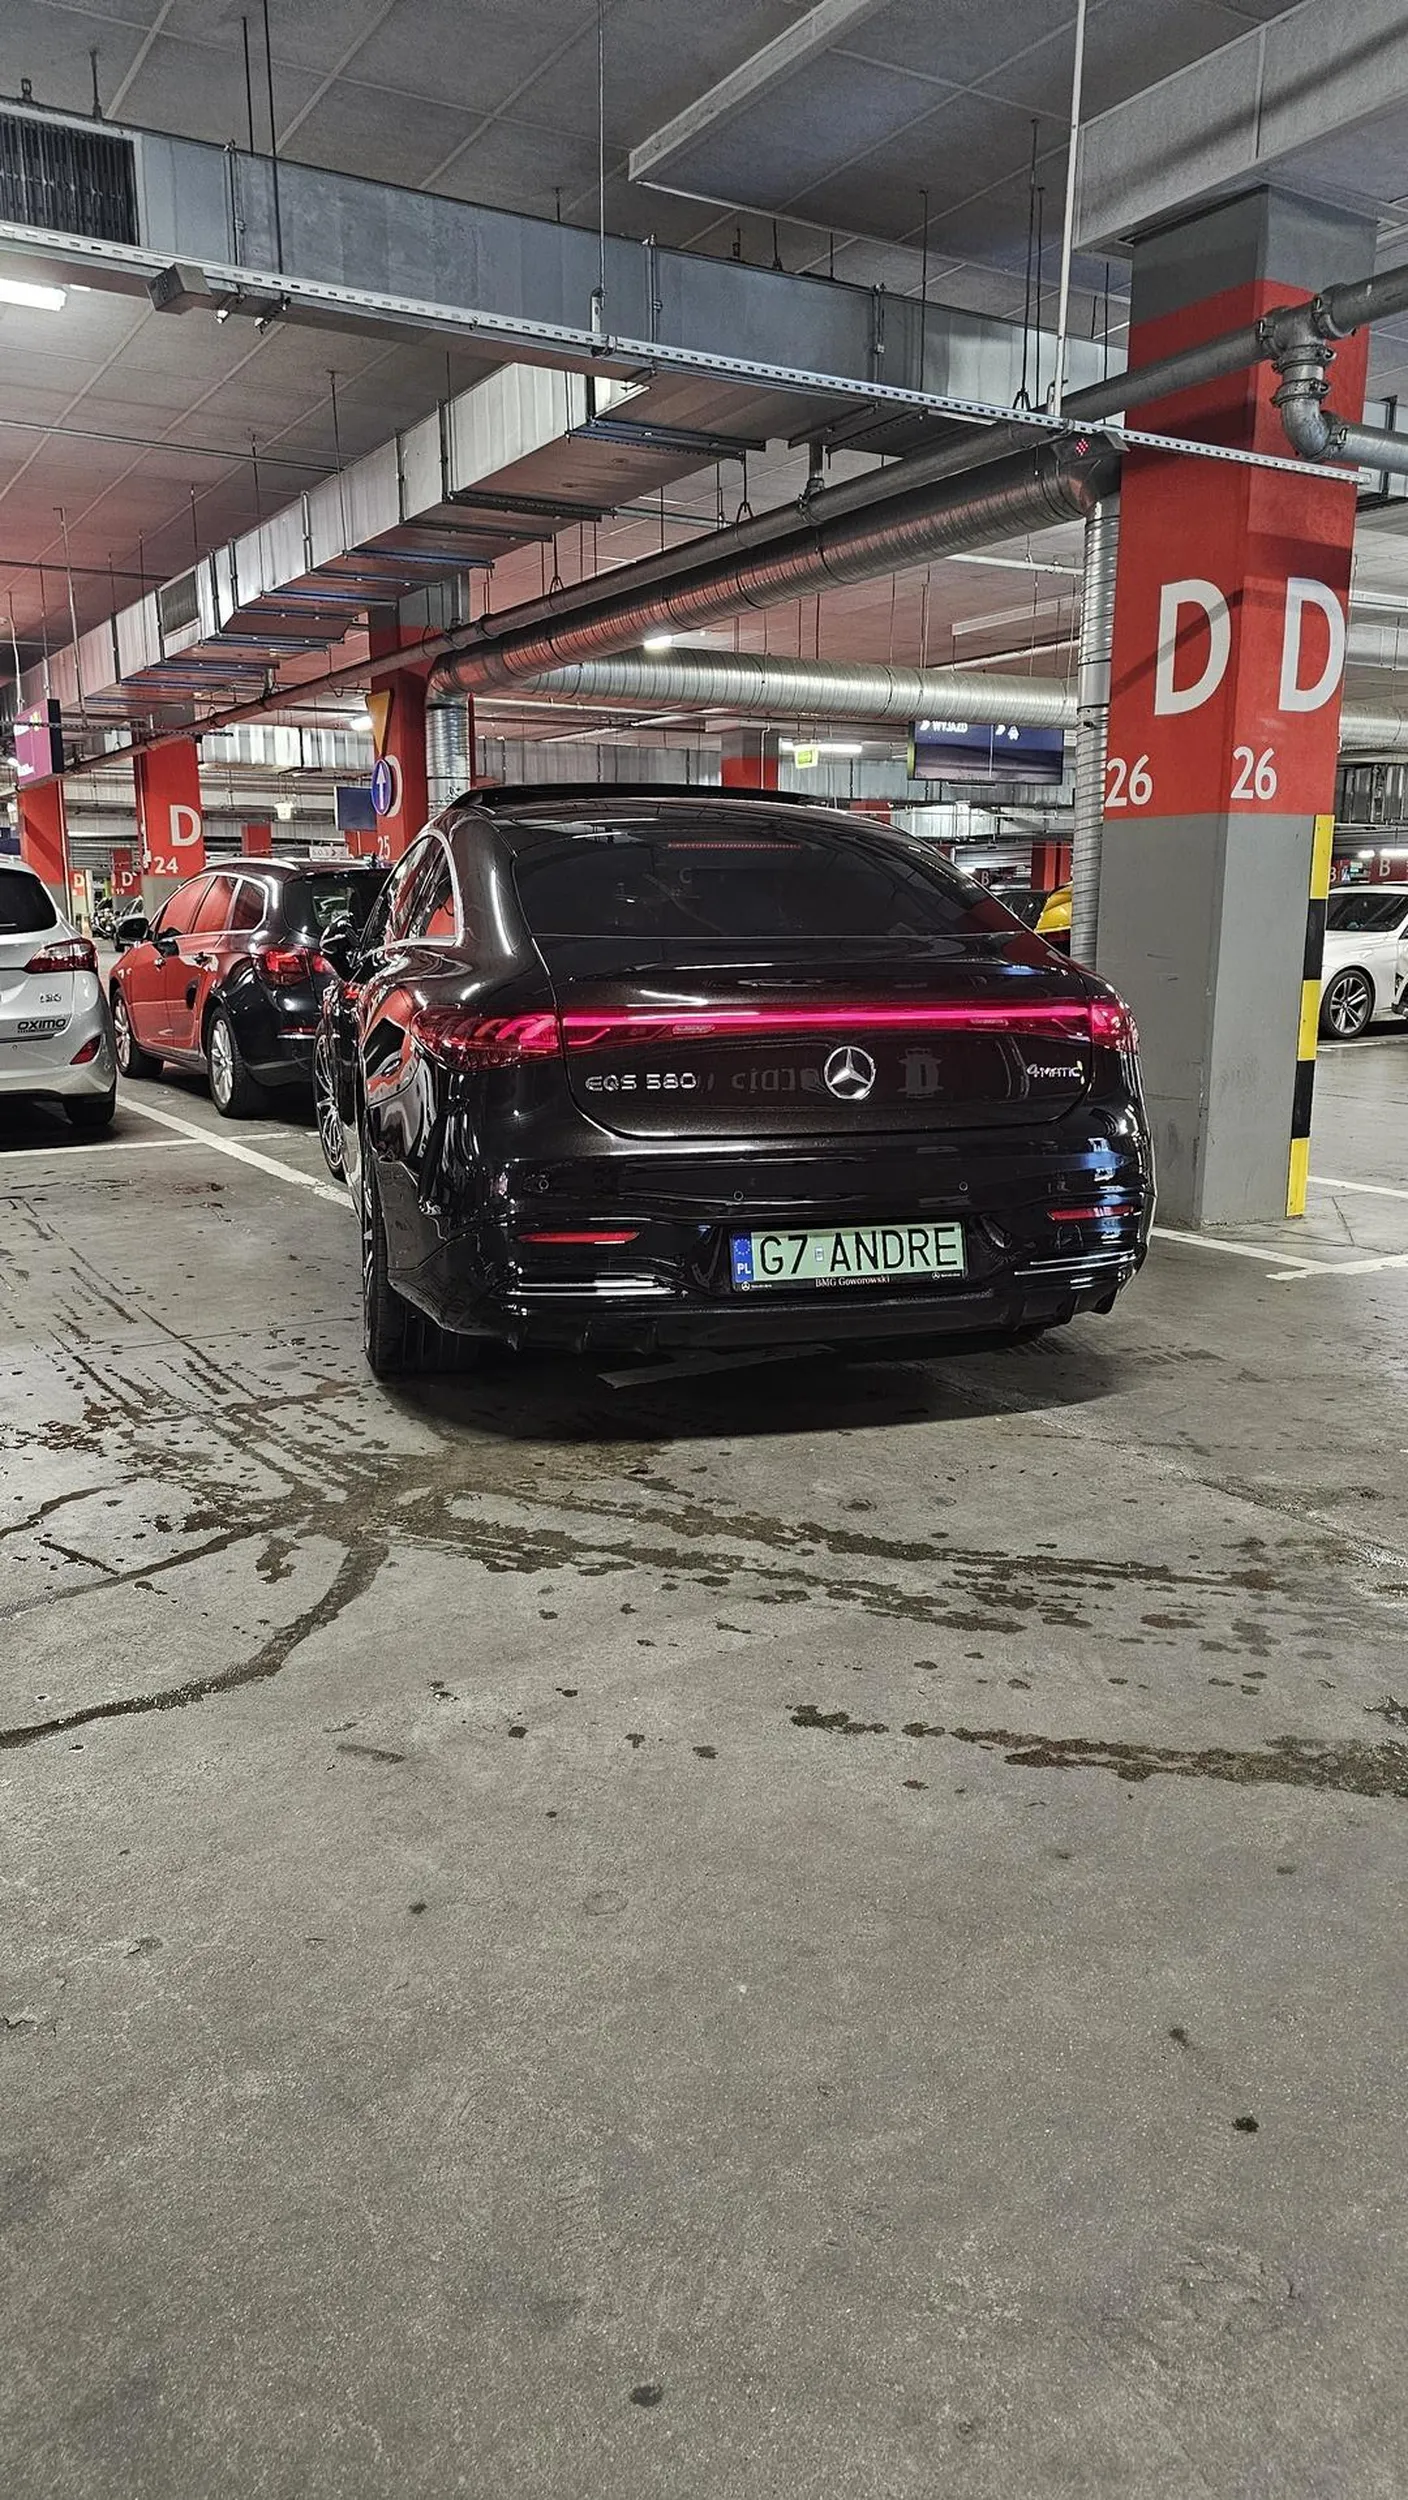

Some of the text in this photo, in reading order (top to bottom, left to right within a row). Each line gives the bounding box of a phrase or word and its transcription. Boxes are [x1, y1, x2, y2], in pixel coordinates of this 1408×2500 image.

[1154, 579, 1231, 716] D
[1279, 577, 1346, 712] D
[1105, 754, 1153, 808] 26
[1230, 746, 1277, 801] 26
[170, 805, 201, 847] D
[378, 836, 391, 860] 25
[154, 856, 179, 874] 24
[1379, 859, 1391, 877] B
[122, 871, 133, 887] D
[981, 871, 990, 886] B
[585, 1072, 697, 1091] EQS 580
[759, 1227, 958, 1275] G7 ANDRE
[737, 1262, 752, 1274] PL
[815, 1274, 890, 1288] BMG Goworowski
